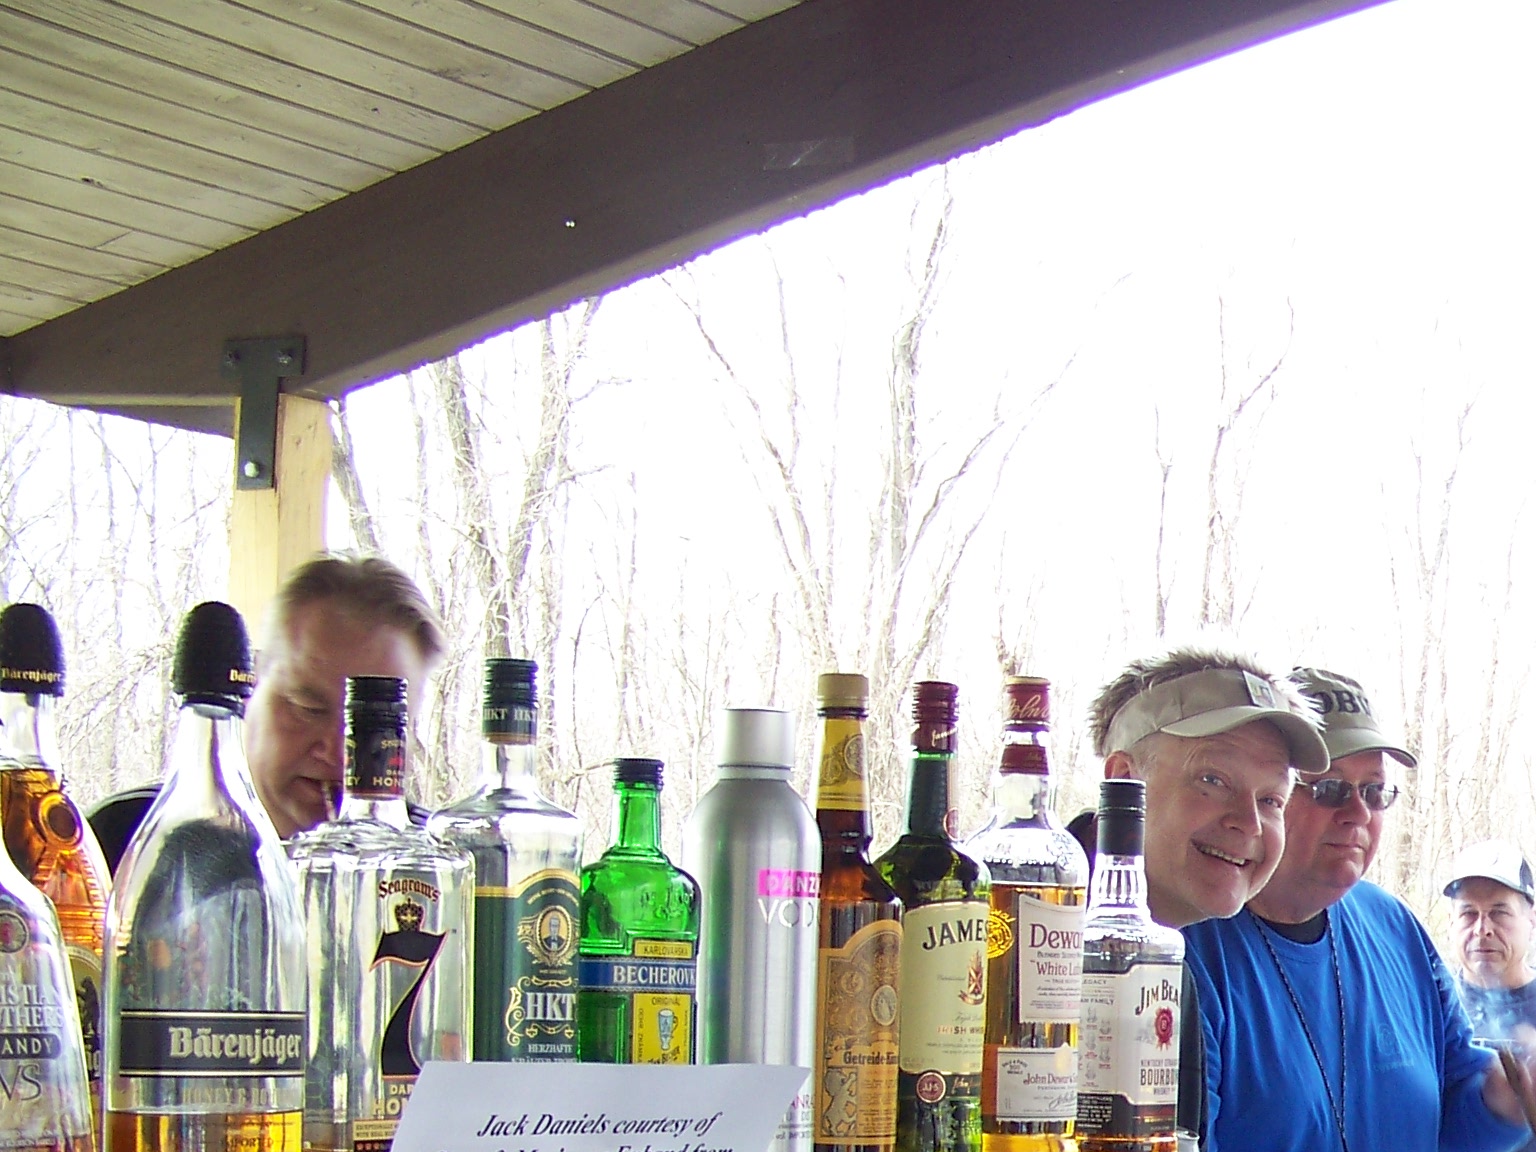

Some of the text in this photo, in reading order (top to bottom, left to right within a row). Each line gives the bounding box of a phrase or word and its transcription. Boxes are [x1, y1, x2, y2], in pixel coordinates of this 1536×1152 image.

[378, 876, 440, 902] Seagram's
[757, 898, 819, 928] VOD
[1036, 961, 1068, 976] White
[1090, 997, 1115, 1007] FAMILY
[1135, 984, 1158, 1015] JIM
[168, 1026, 302, 1065] Bärenjäger
[1023, 1072, 1047, 1085] John
[476, 1111, 723, 1144] Jack Daniels courtesy of
